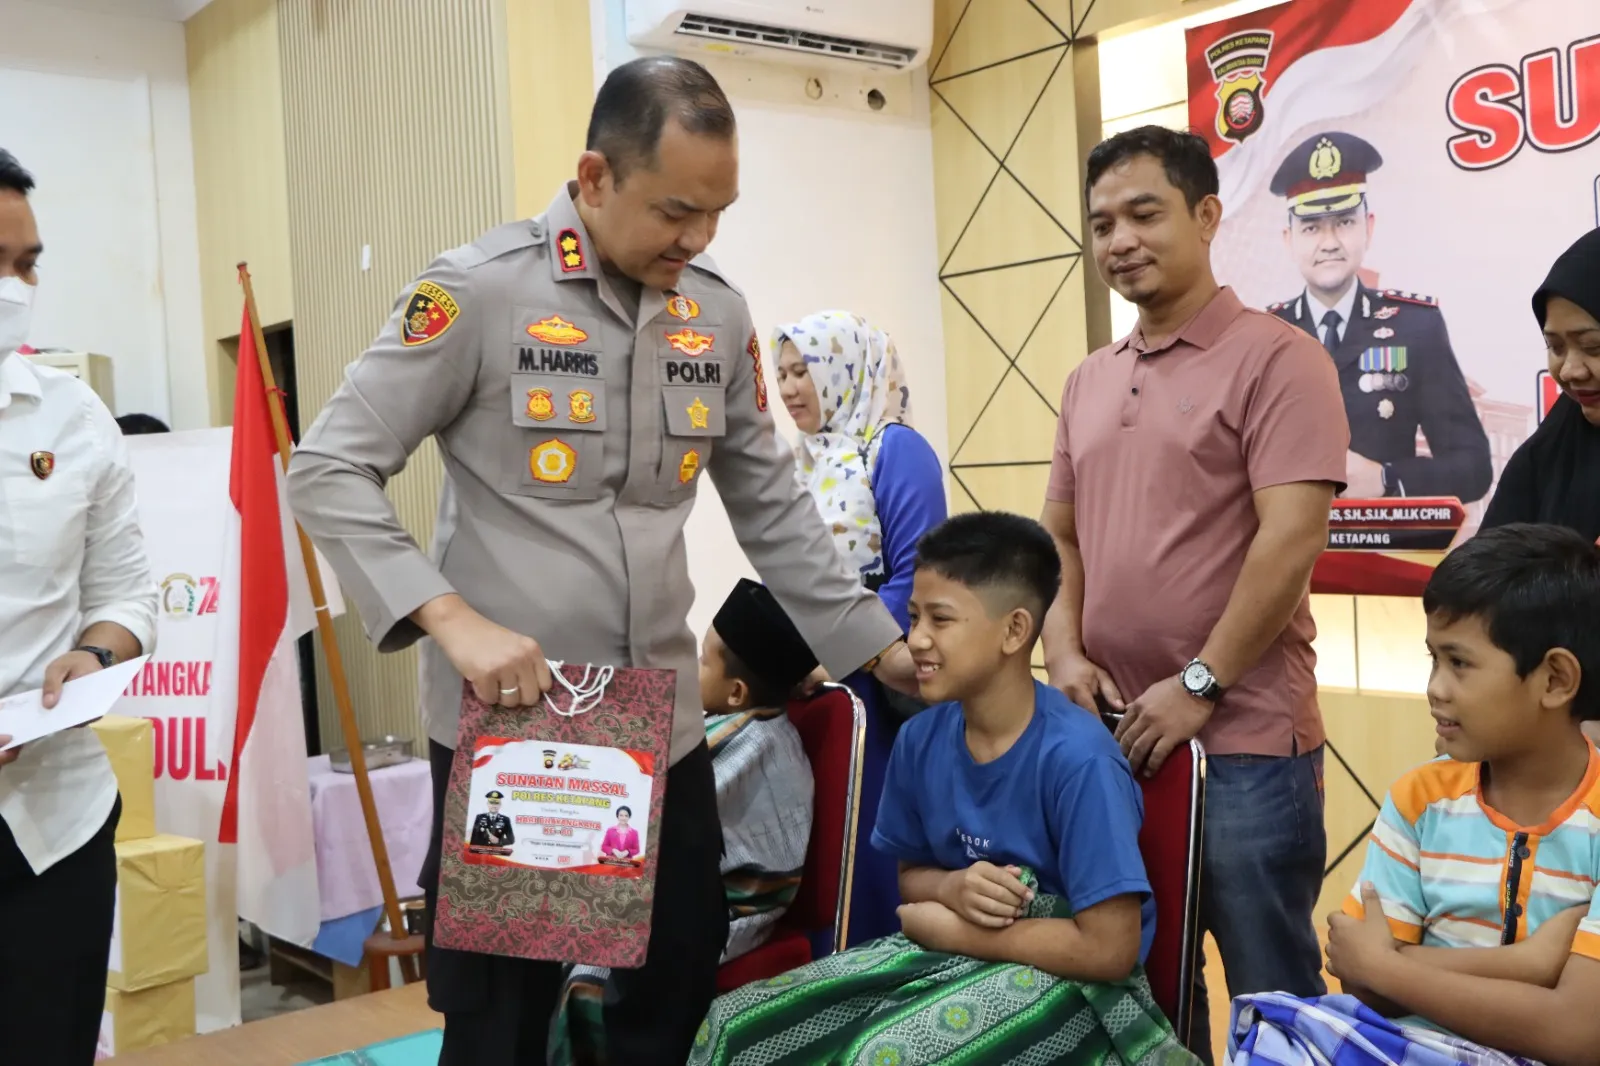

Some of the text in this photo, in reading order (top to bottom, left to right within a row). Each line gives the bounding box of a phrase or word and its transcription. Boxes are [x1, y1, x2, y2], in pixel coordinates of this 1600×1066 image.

[420, 284, 458, 317] RESERSE
[667, 361, 720, 384] POLRI
[1420, 508, 1451, 520] CPHR
[1331, 533, 1391, 545] KETAPANG
[496, 772, 630, 799] SUNATAN MASSAL
[512, 790, 611, 809] POLRES KETAPANG
[516, 815, 538, 825] HARI
